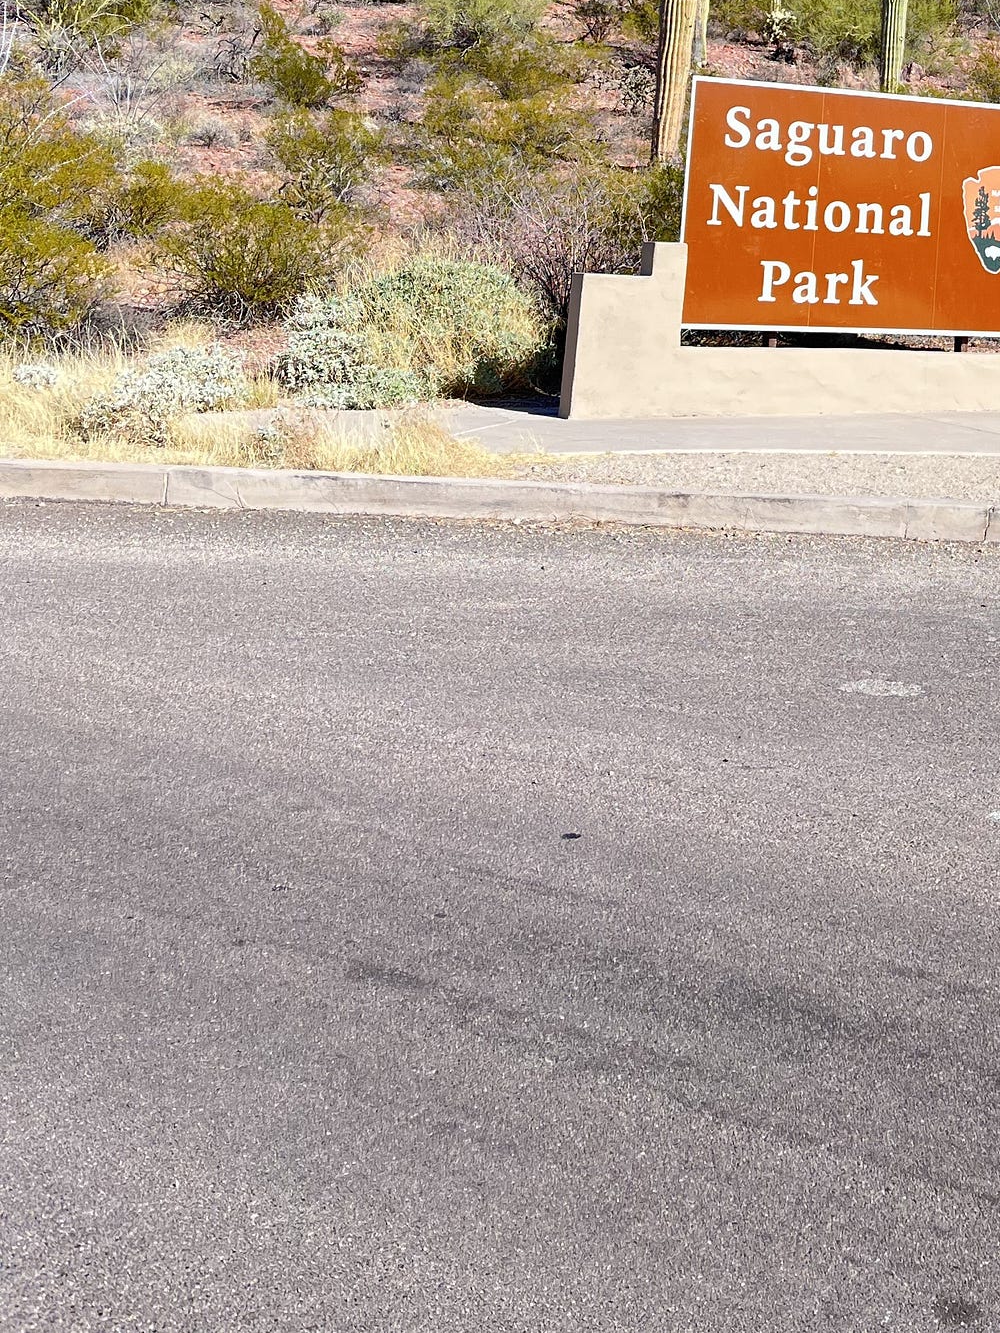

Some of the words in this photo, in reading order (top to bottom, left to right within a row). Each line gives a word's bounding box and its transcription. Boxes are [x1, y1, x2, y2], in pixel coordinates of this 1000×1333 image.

[724, 106, 934, 167] Saguaro
[706, 184, 932, 237] National
[757, 259, 880, 306] Park
